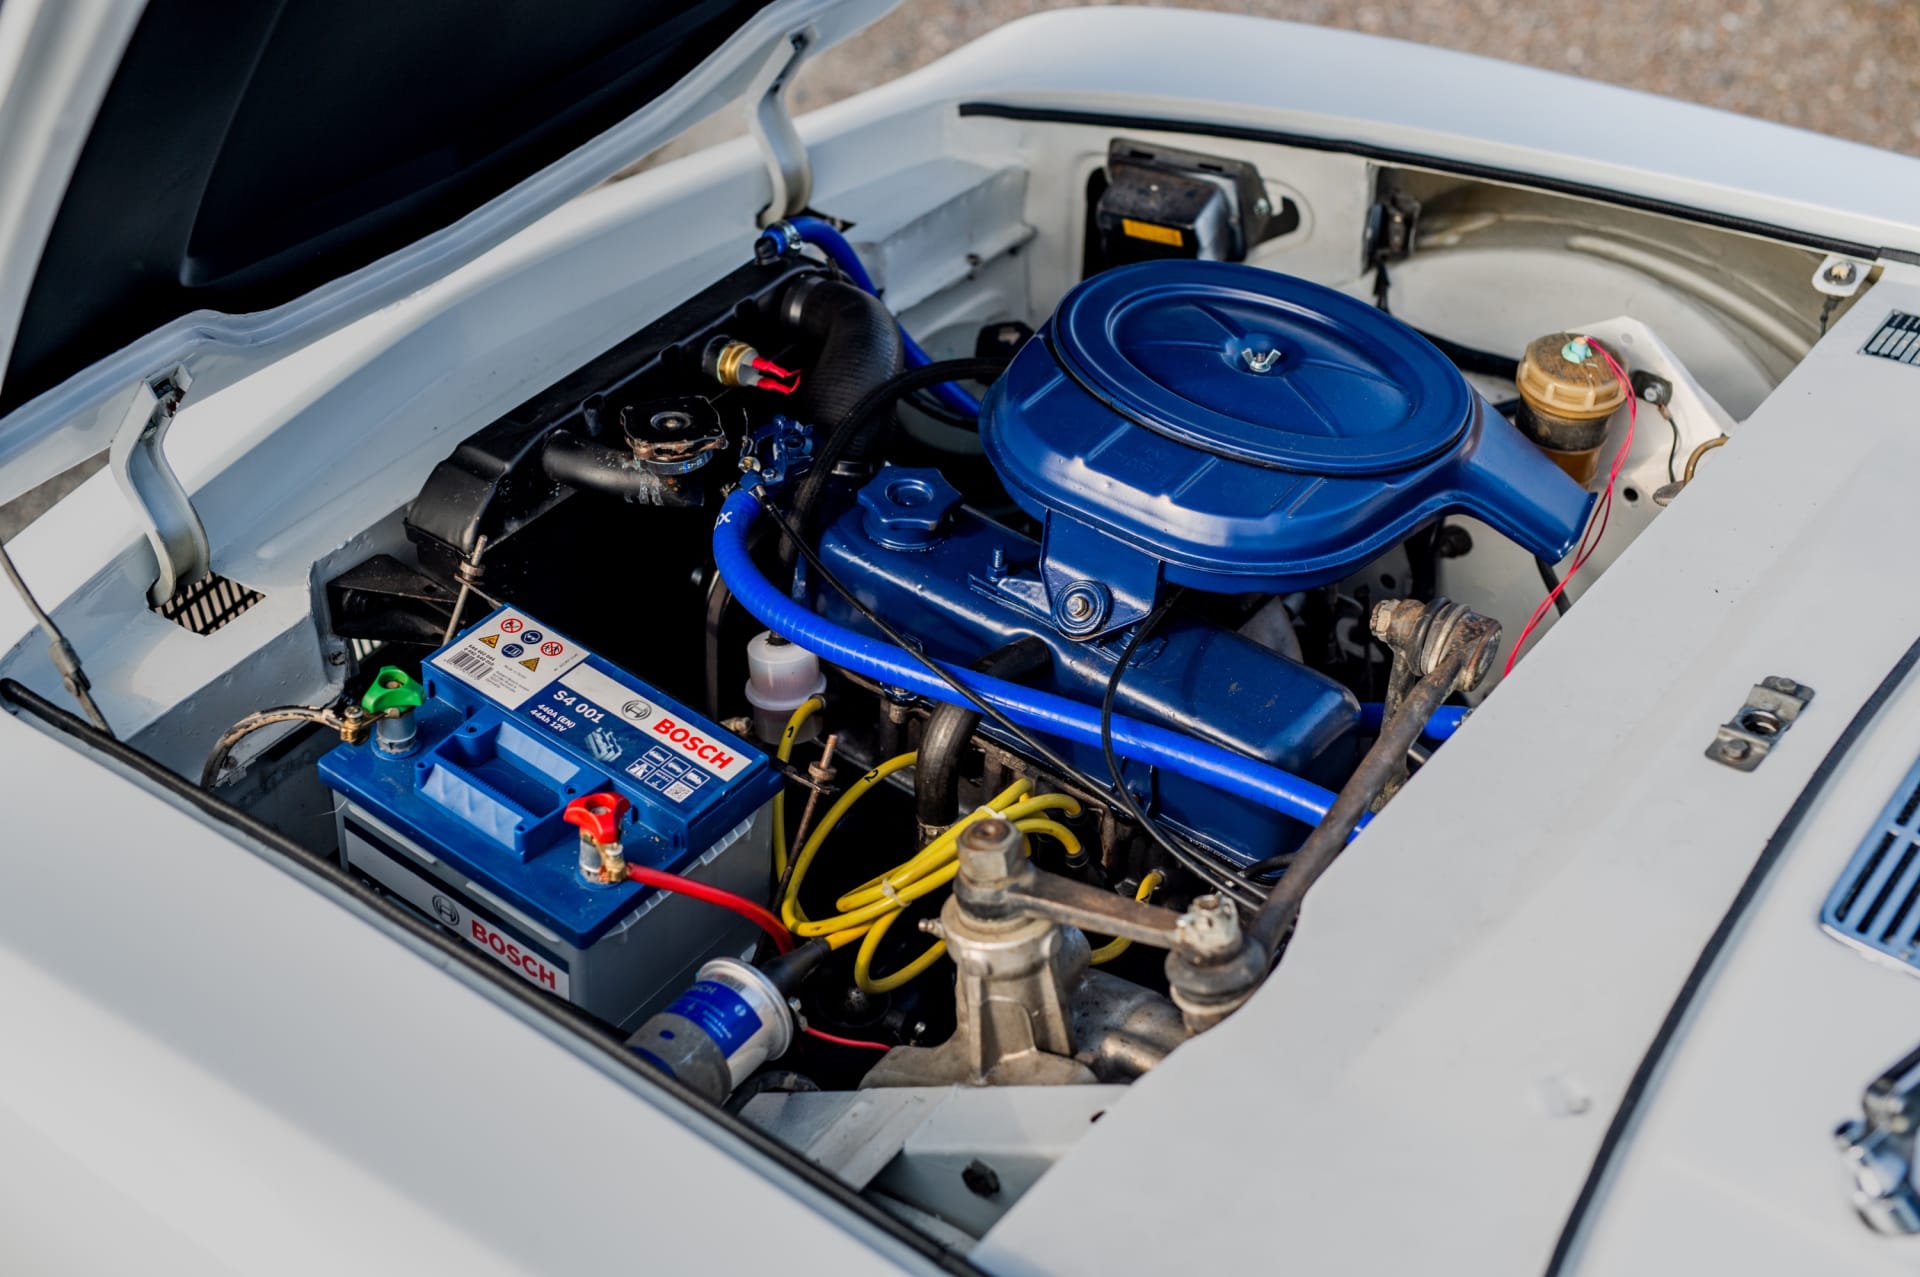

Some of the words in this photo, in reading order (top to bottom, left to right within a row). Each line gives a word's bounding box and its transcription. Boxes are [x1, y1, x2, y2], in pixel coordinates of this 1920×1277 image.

[537, 704, 558, 718] 440A
[557, 715, 576, 729] (EN)
[553, 690, 577, 706] S4
[575, 703, 605, 724] 001
[530, 709, 551, 724] 44Ah
[549, 721, 567, 732] 12V
[786, 725, 795, 738] 1
[652, 718, 735, 770] BOSCH
[863, 769, 879, 783] 2
[471, 919, 556, 991] BOSCH
